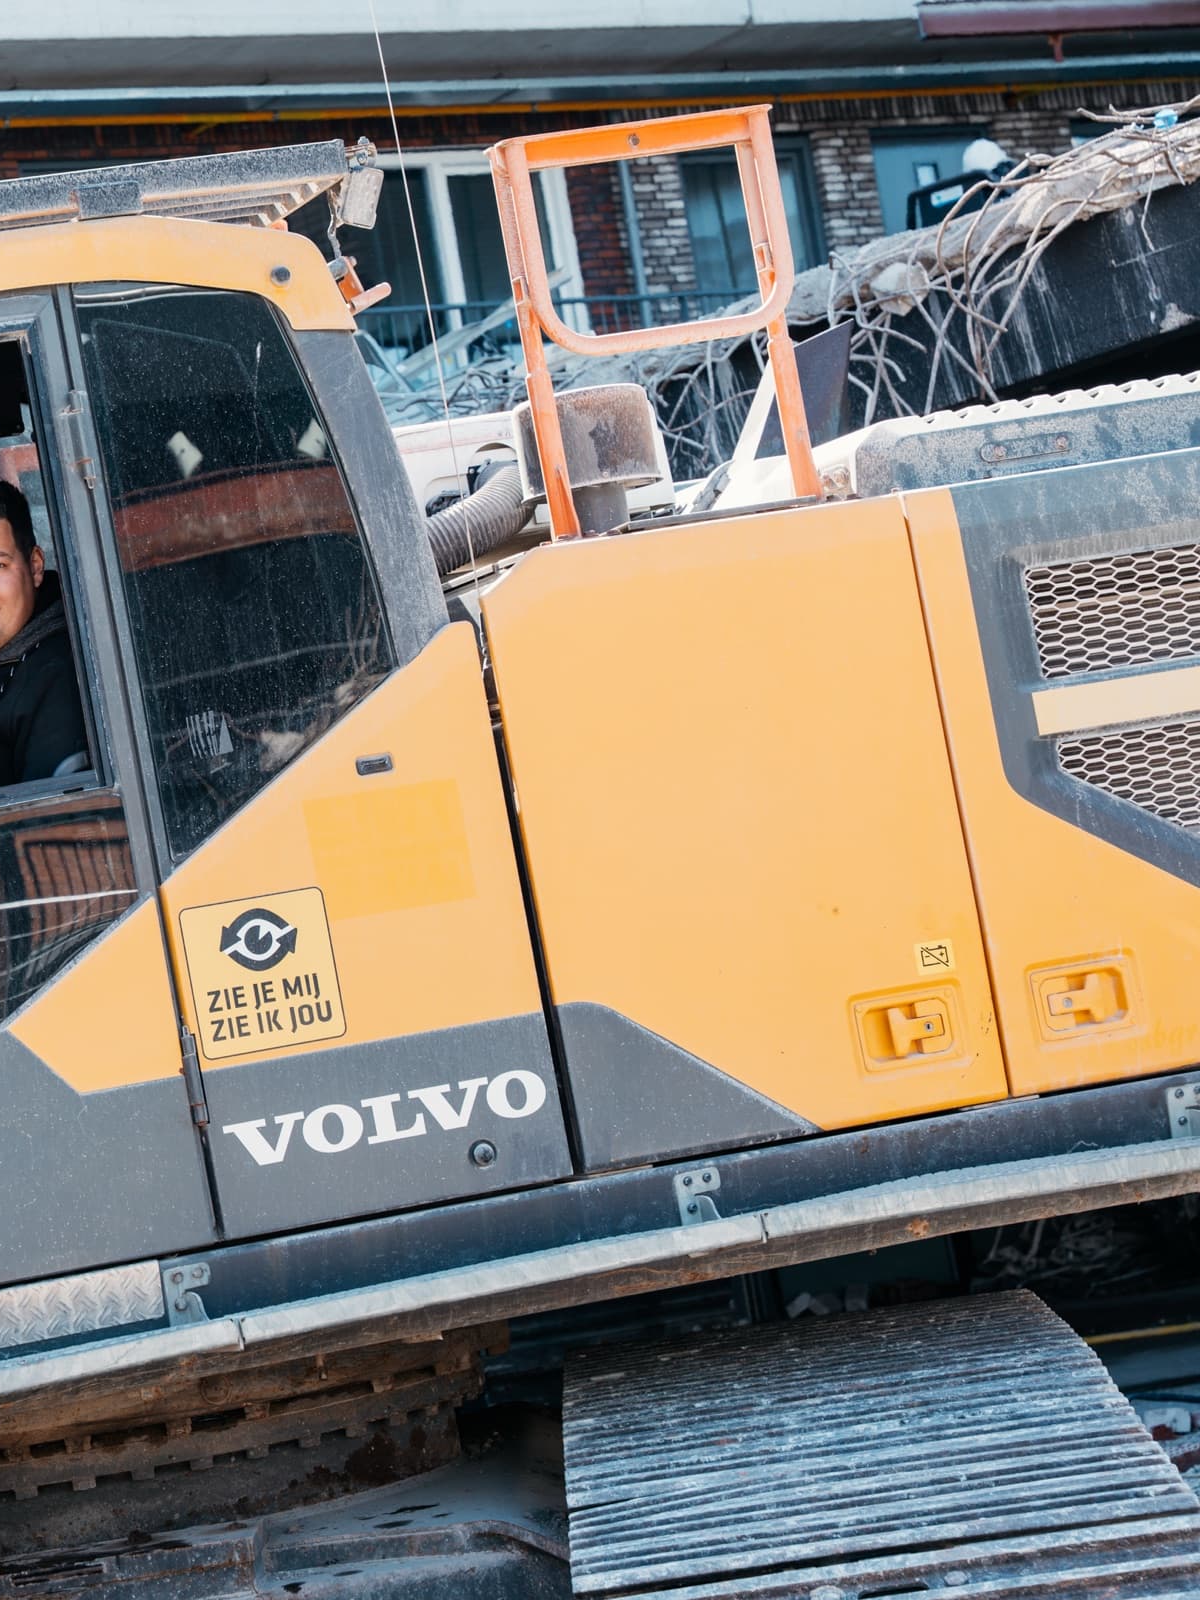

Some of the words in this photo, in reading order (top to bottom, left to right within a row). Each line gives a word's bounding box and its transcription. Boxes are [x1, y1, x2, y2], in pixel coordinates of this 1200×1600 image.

[207, 985, 248, 1013] ZIE
[252, 980, 277, 1010] JE
[281, 972, 321, 999] MIJ
[210, 1014, 251, 1042] ZIE
[256, 1008, 284, 1034] IK
[289, 999, 333, 1034] JOU
[221, 1069, 547, 1167] VOLVO
